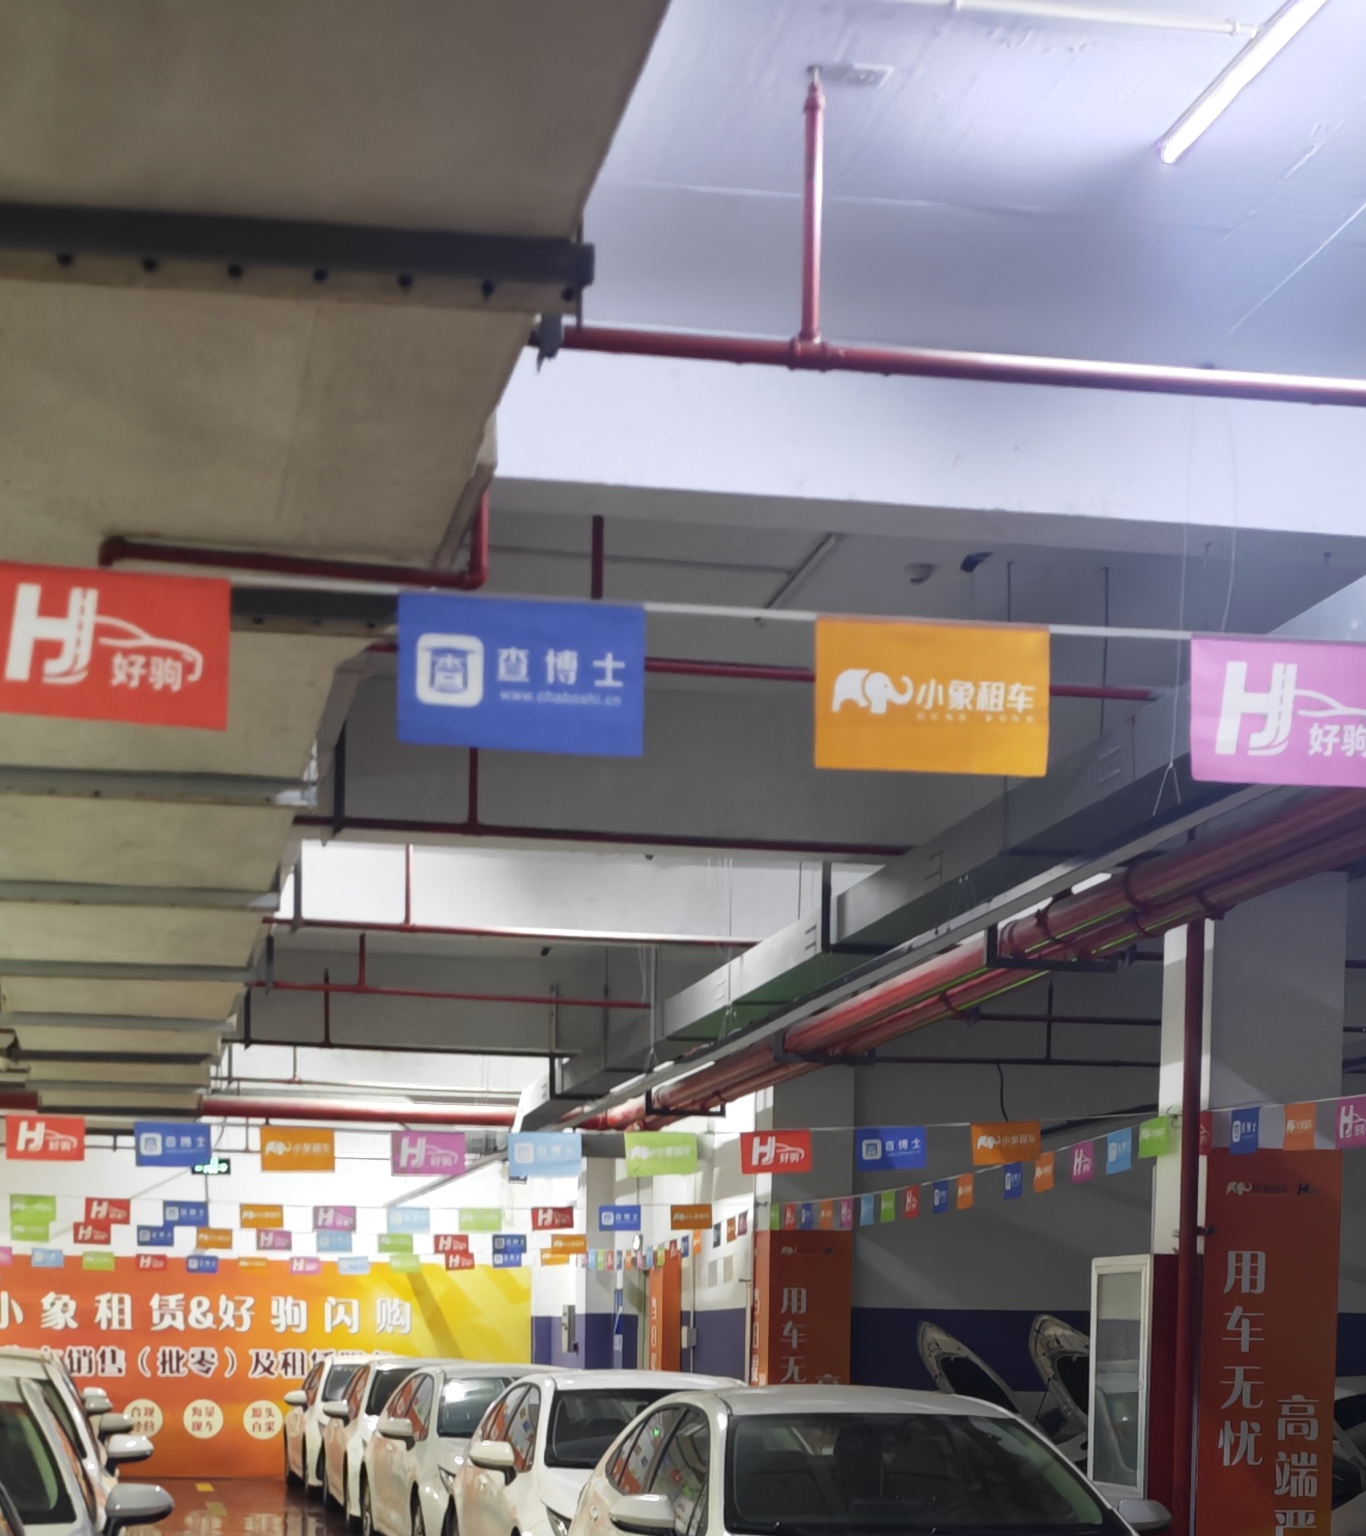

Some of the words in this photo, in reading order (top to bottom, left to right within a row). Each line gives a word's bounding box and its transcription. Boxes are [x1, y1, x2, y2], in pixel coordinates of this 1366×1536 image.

[112, 653, 182, 691] 好驹
[497, 647, 625, 688] 查博士
[916, 679, 1036, 714] 小象租车
[1217, 1249, 1267, 1469] 用车无忧
